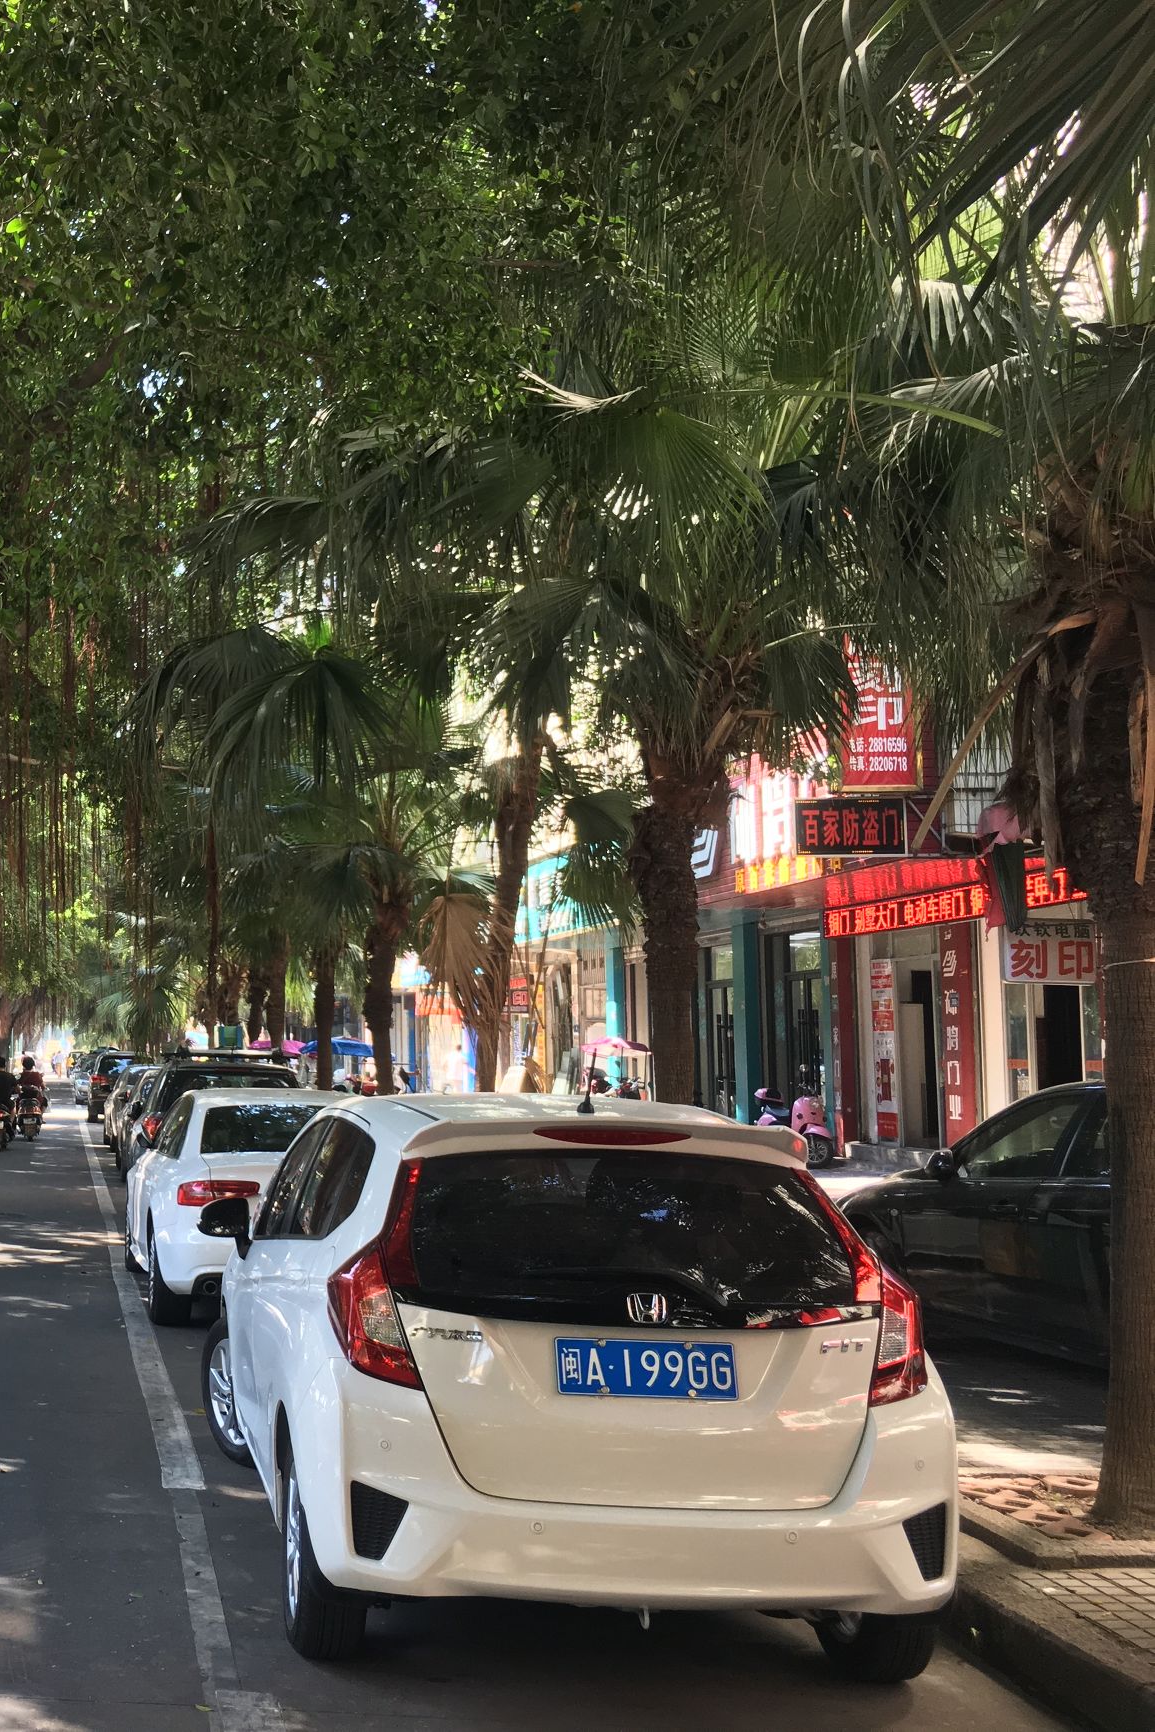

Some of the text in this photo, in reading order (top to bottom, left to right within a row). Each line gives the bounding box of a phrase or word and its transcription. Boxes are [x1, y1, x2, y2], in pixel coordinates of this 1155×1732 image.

[801, 807, 899, 847] 百家防盗门
[855, 903, 898, 934] 别墅大门
[904, 891, 965, 925] 电动车库门
[1010, 940, 1094, 979] 刻印
[830, 961, 842, 1110] 原家门业
[820, 1338, 871, 1355] FIT
